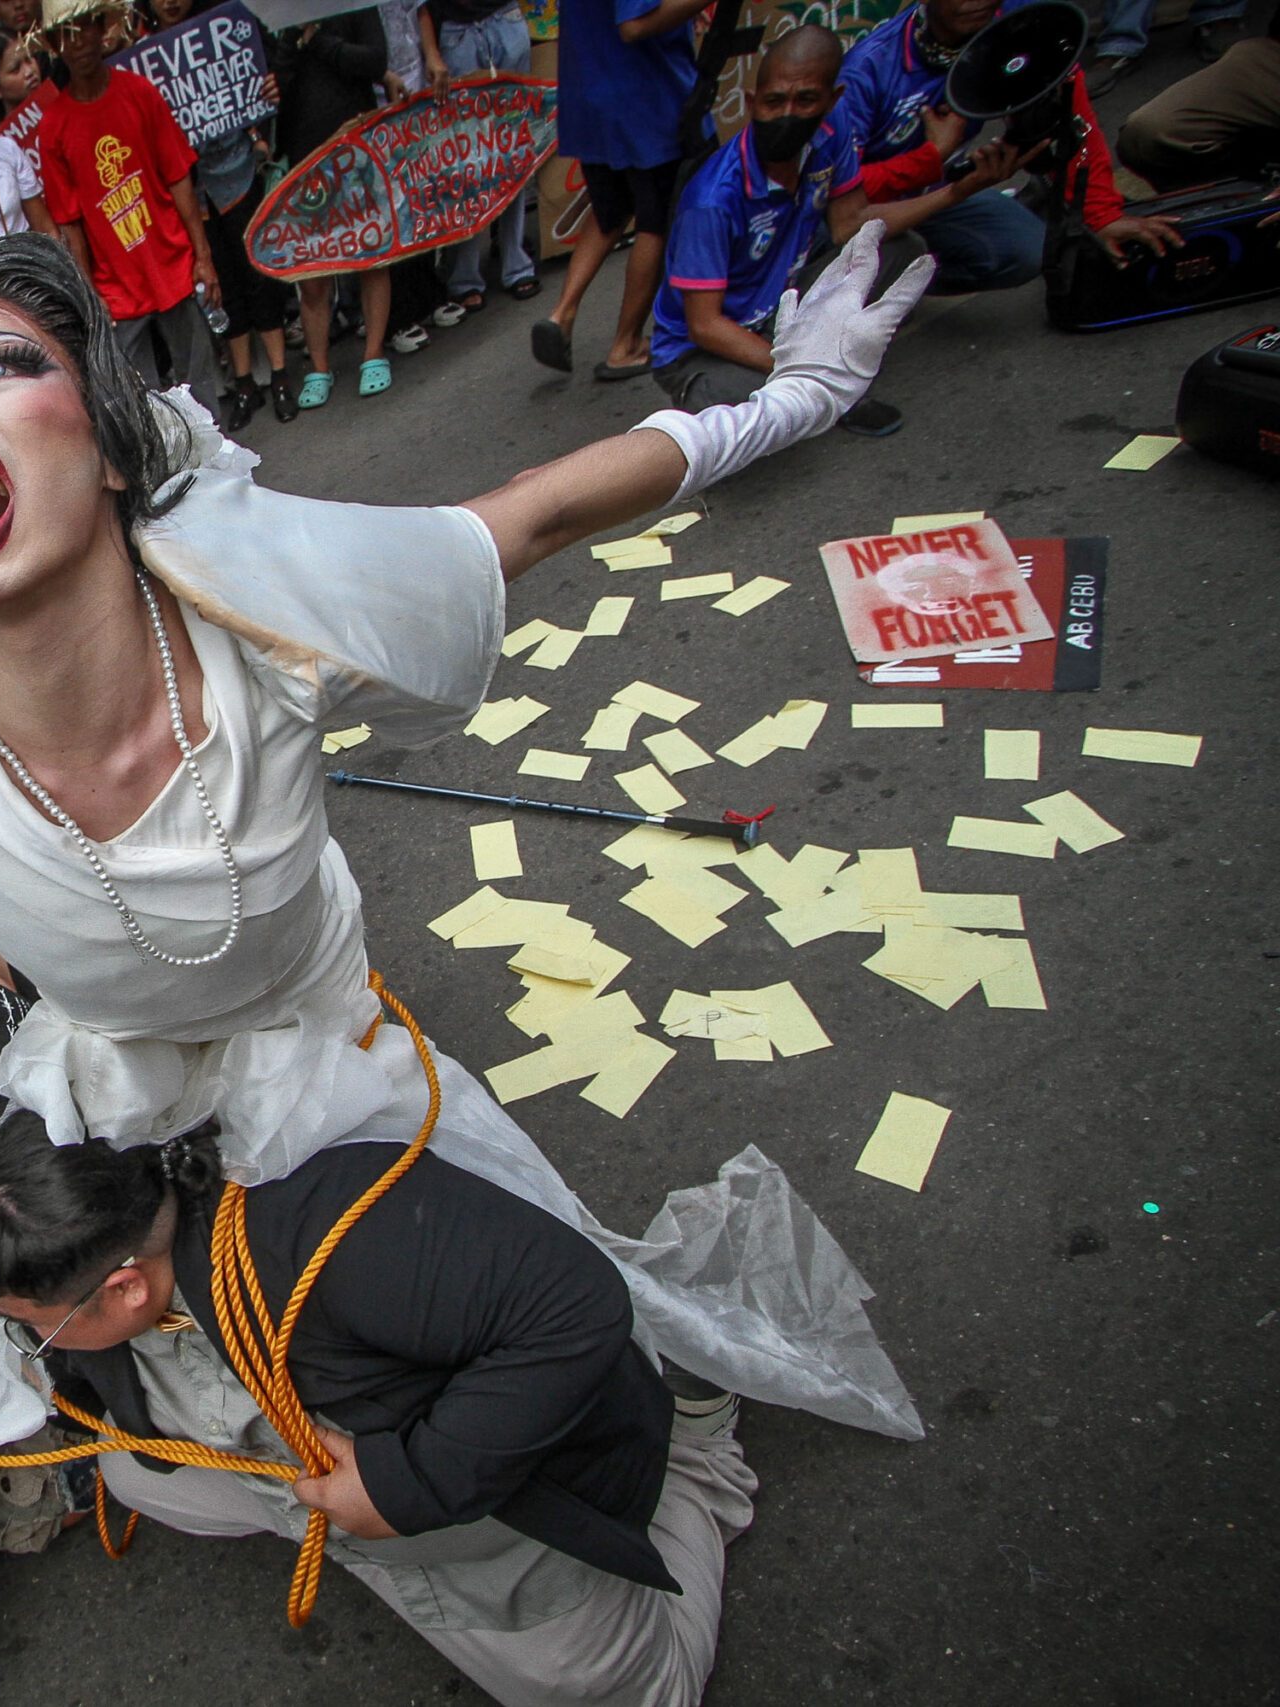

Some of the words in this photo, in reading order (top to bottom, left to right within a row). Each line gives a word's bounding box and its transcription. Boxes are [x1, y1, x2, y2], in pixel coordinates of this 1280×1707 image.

[196, 48, 258, 97] NEVER
[845, 526, 989, 579] NEVER
[1070, 574, 1096, 618] CEBU
[871, 590, 1029, 652] FORGET
[1065, 621, 1093, 650] AB
